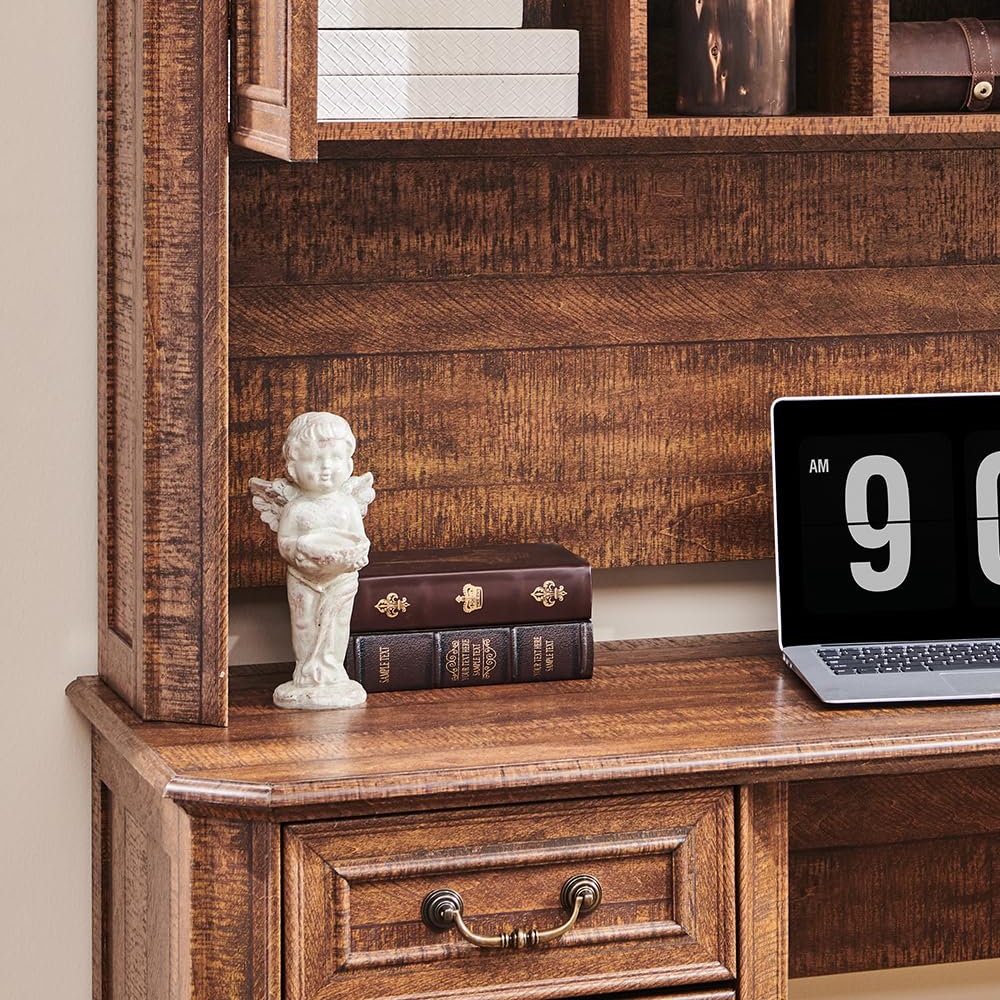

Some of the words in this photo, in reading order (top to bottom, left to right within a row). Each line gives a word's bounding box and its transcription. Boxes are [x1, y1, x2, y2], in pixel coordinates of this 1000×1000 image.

[808, 458, 830, 474] AM
[844, 454, 911, 592] 9
[462, 638, 470, 653] HERE
[533, 636, 542, 650] HERE
[545, 640, 554, 653] TEXT
[380, 646, 390, 661] TEXT
[462, 654, 470, 666] TEXT
[533, 650, 542, 662] TEXT
[545, 654, 554, 672] SAMPLE
[380, 661, 390, 684] SAMPLE
